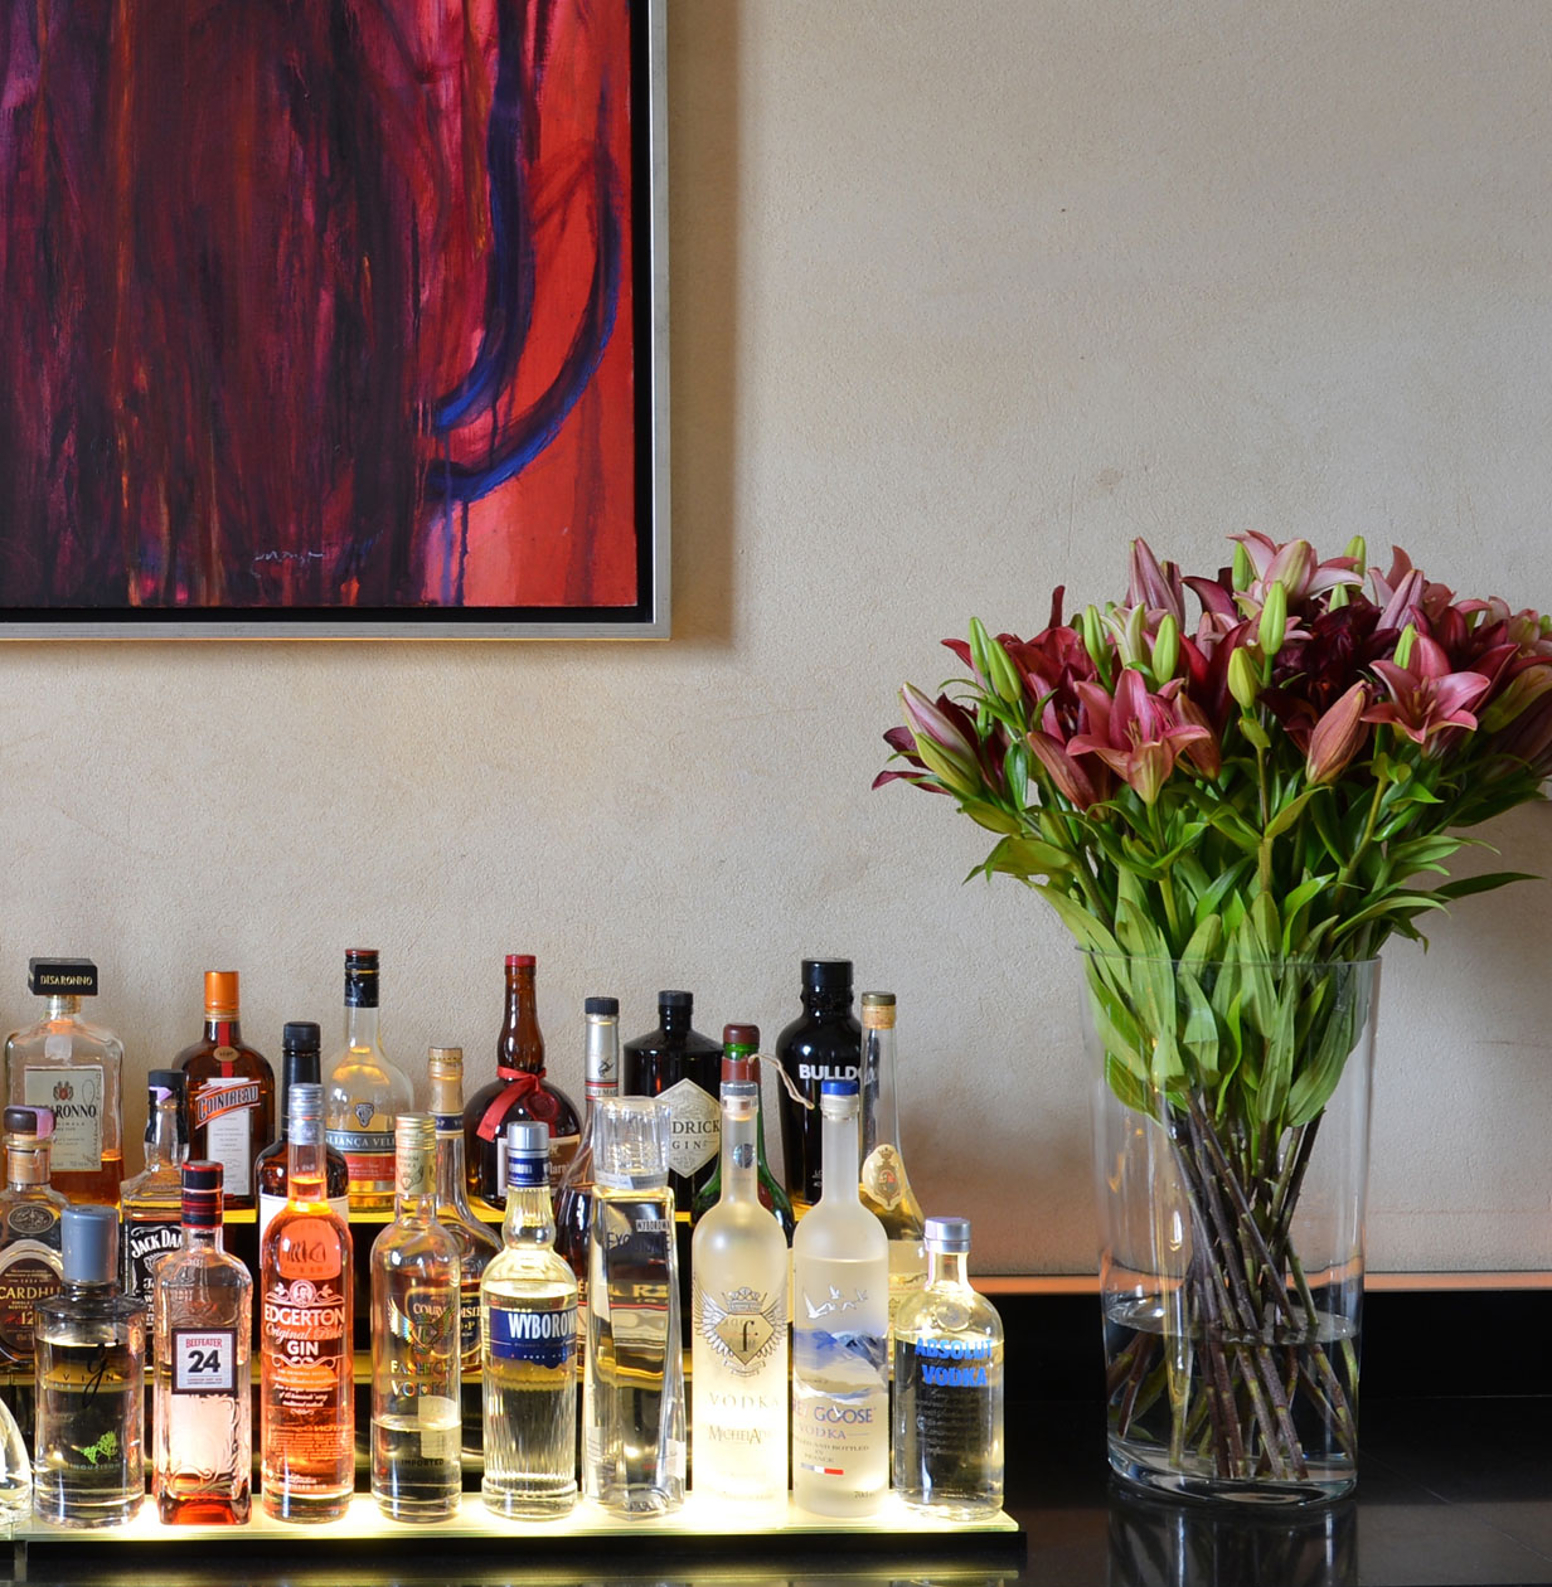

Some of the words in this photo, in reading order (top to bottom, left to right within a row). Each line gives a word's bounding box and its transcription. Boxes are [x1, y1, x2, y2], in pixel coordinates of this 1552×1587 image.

[40, 975, 93, 986] DISARONNO
[799, 1064, 860, 1080] BULLD
[53, 1104, 97, 1119] RONNO
[198, 1085, 258, 1121] COINTREAU
[673, 1119, 720, 1134] DRICK
[672, 1140, 701, 1150] GIN
[130, 1235, 161, 1258] JACK
[21, 1311, 34, 1325] 12
[264, 1303, 345, 1327] EDGERTON
[266, 1323, 312, 1344] Original
[186, 1338, 222, 1348] BEEFEATER
[287, 1340, 319, 1356] GIN
[915, 1337, 992, 1360] ABSOLUT
[188, 1350, 221, 1373] 24
[922, 1364, 987, 1387] VODKA
[814, 1406, 874, 1424] GOOSE
[799, 1422, 847, 1440] VODKA
